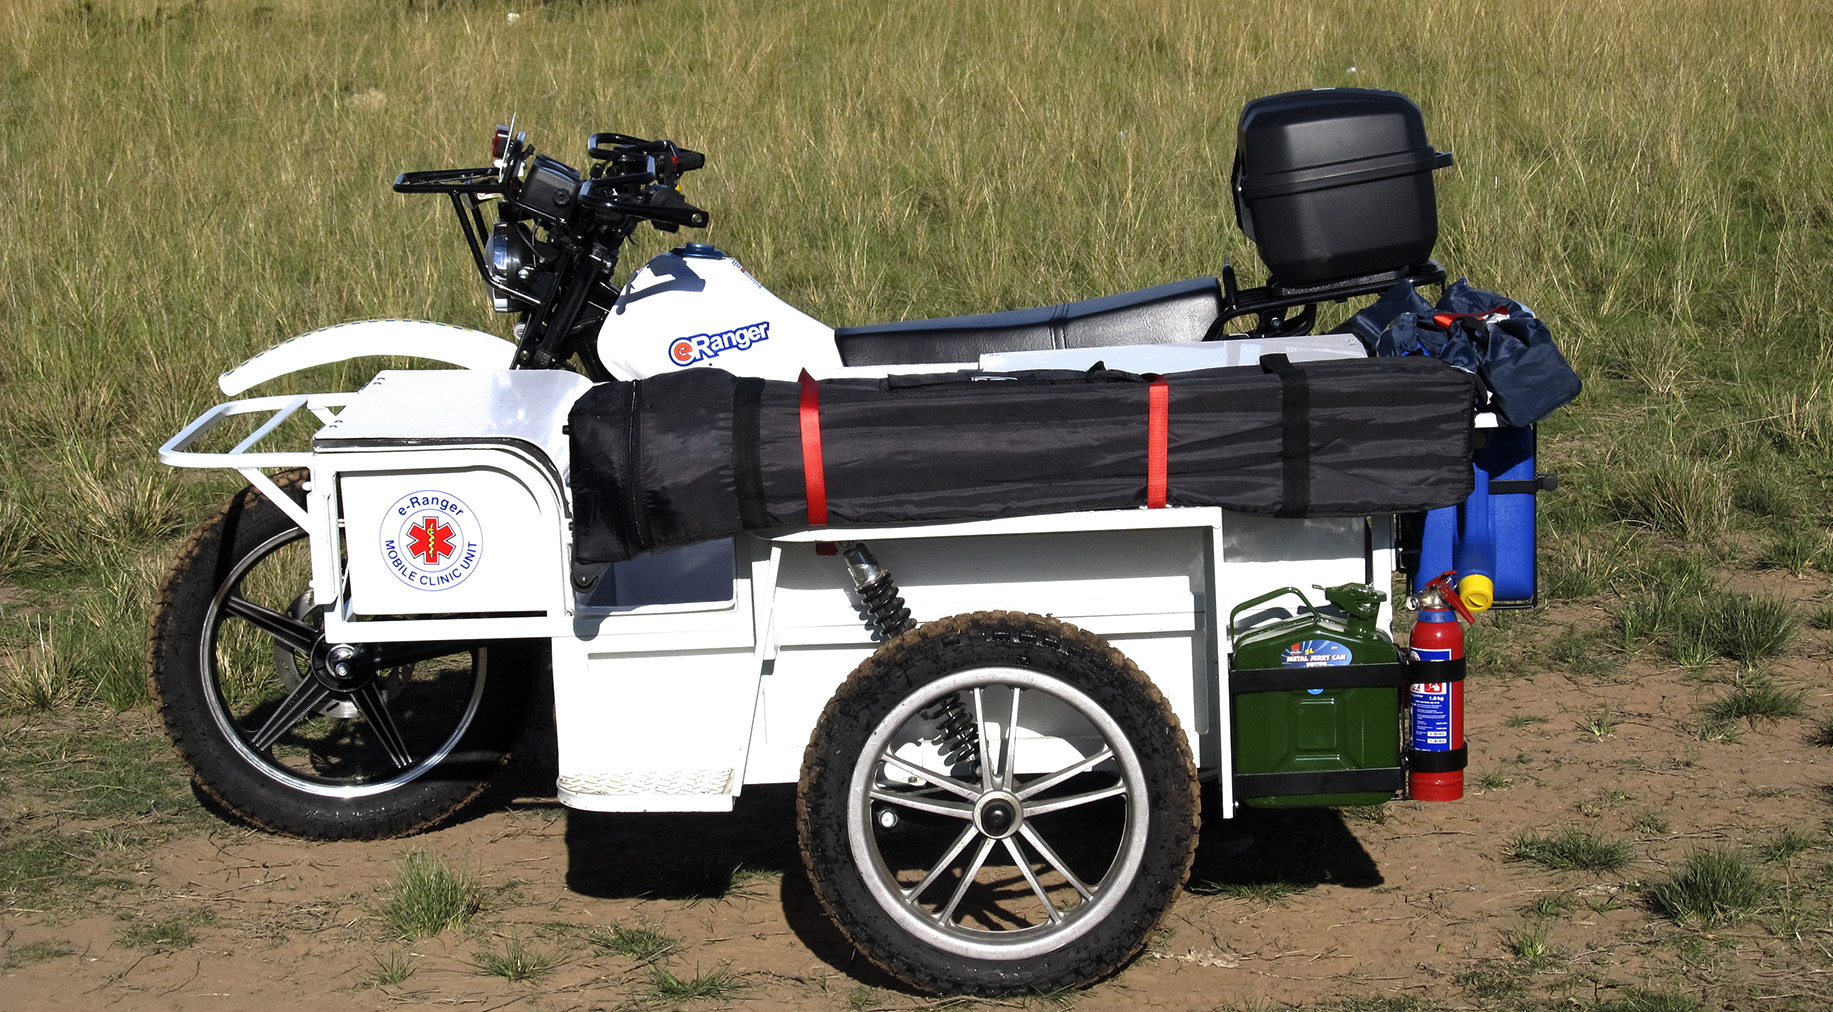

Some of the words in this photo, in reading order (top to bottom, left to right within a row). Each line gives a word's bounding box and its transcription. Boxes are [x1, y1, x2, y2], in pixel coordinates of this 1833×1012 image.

[668, 321, 770, 367] eRanger
[398, 496, 464, 516] e-Ranger
[385, 539, 418, 582] MOBILE
[419, 568, 462, 586] CLINIC
[460, 541, 477, 570] UNIT
